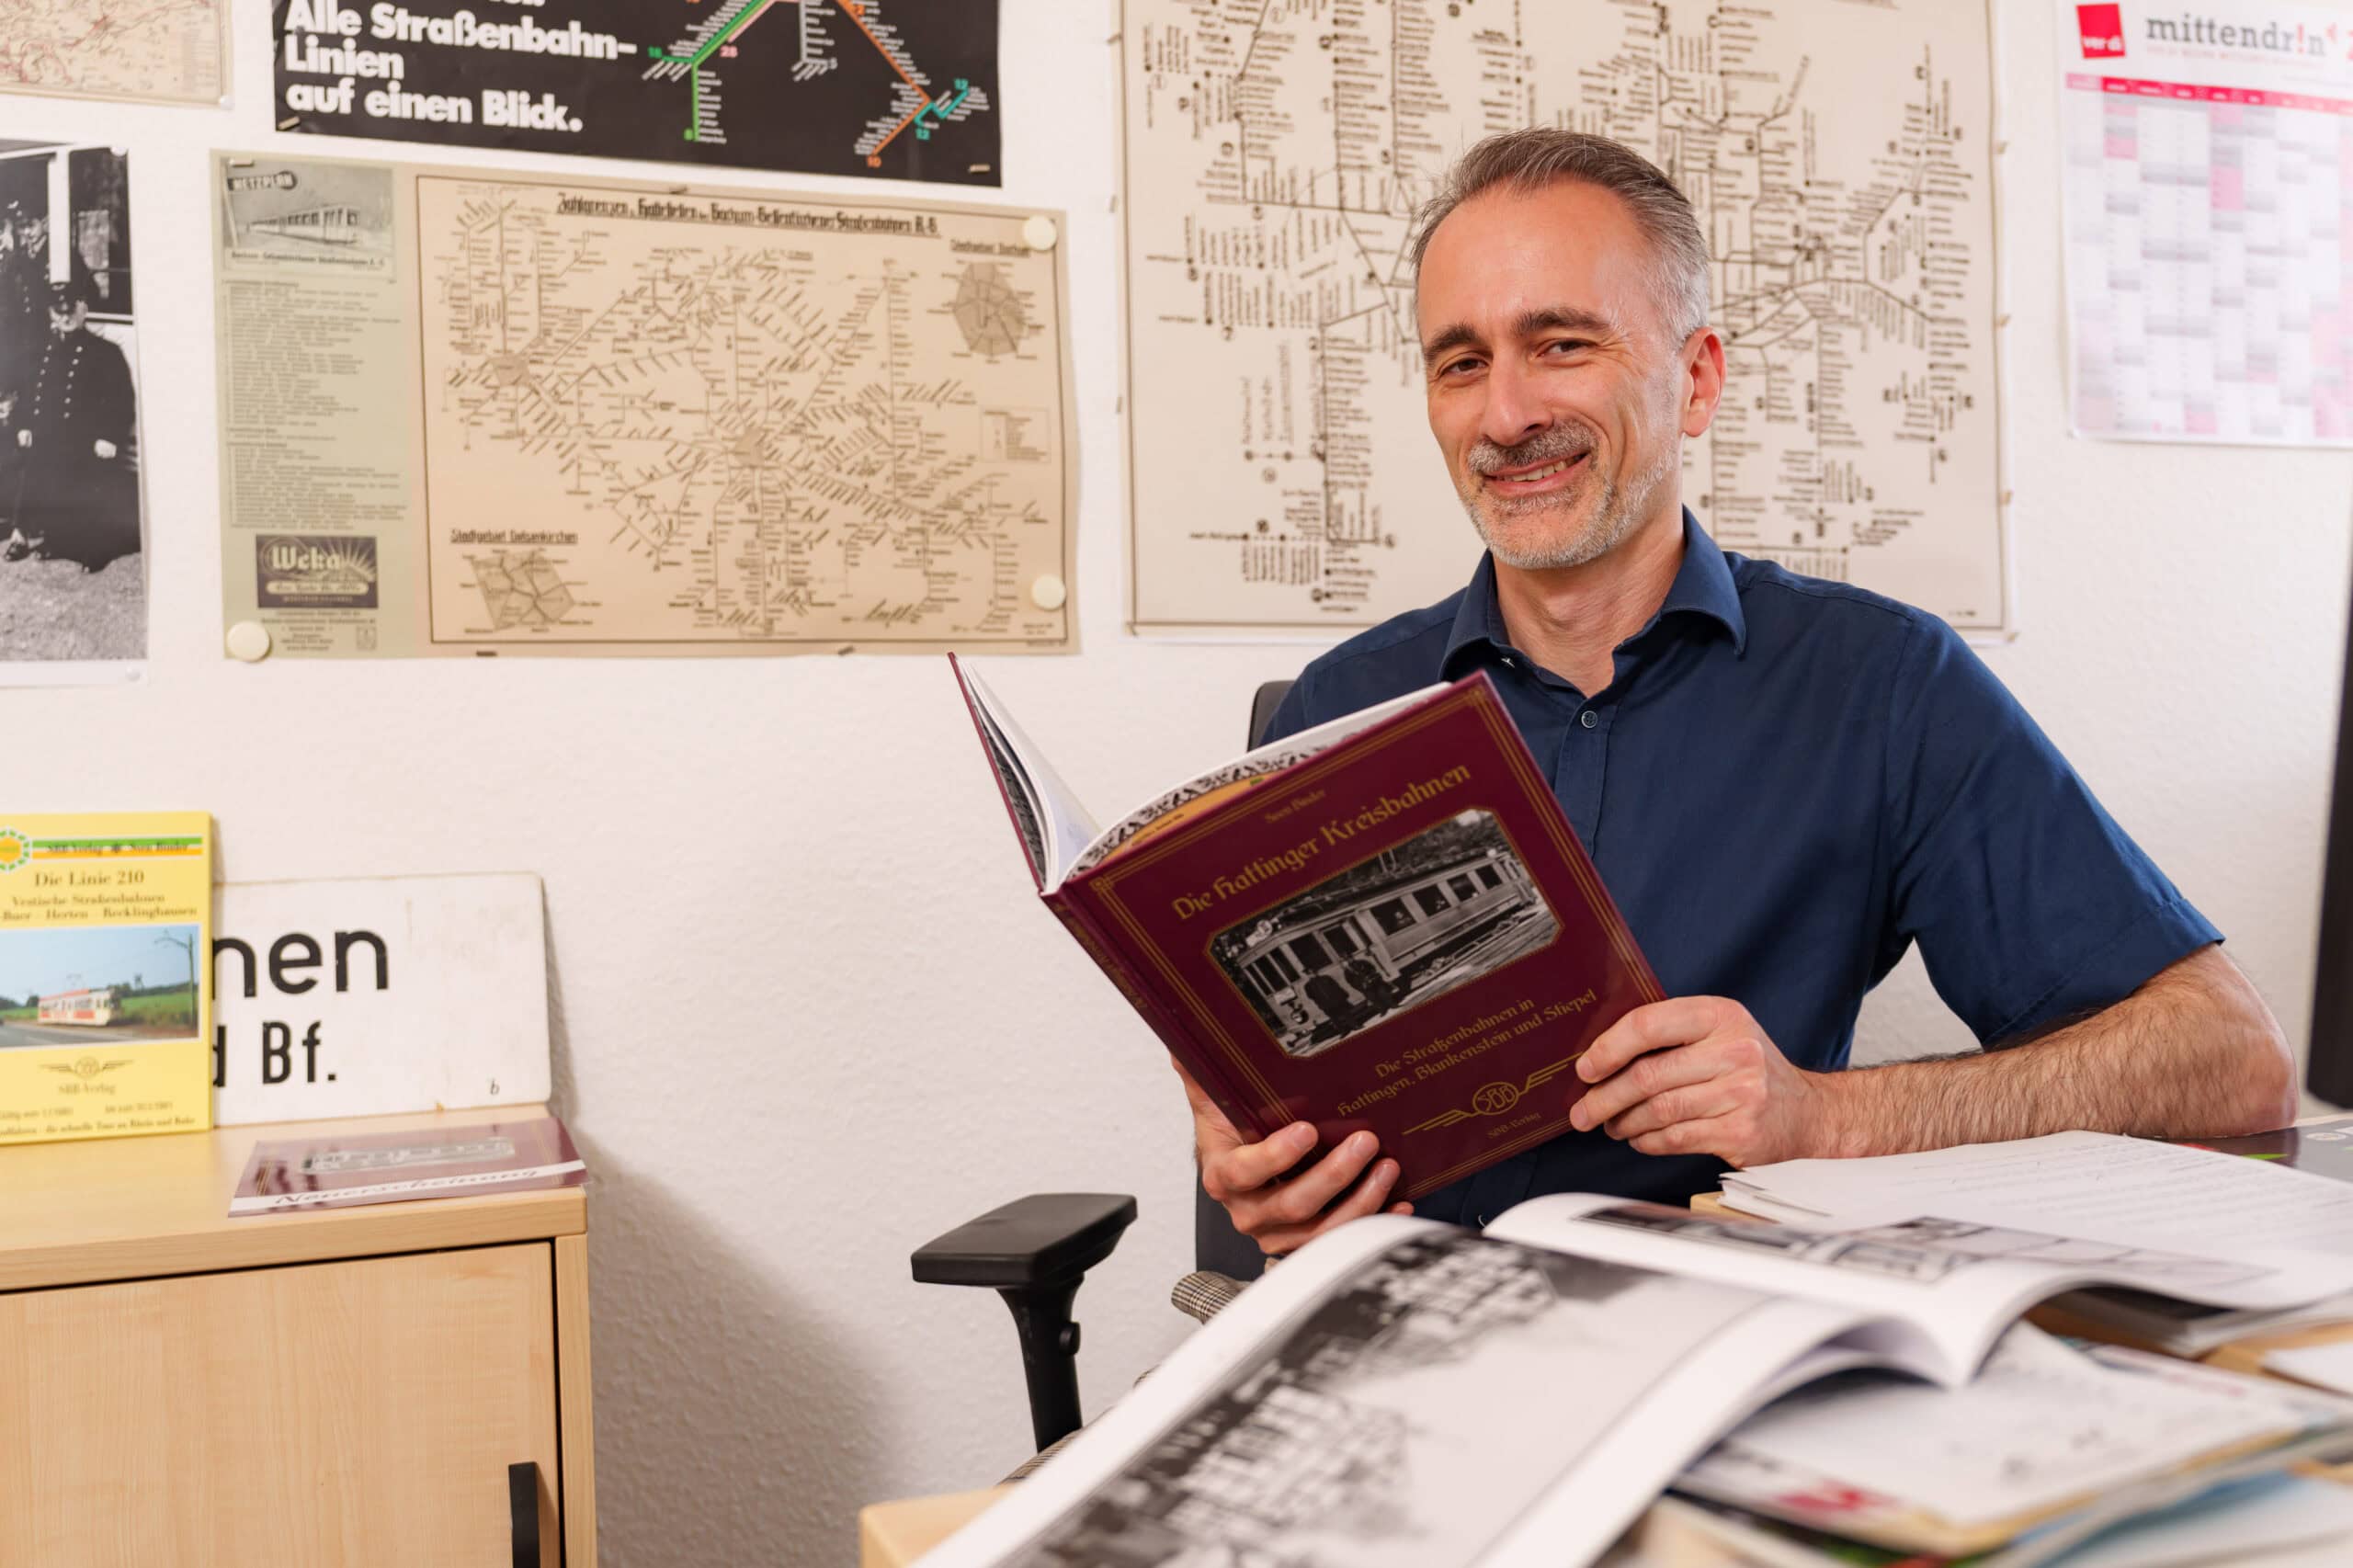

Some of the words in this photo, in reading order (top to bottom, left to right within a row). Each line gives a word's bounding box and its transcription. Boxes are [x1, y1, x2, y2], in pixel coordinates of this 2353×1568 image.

[284, 0, 362, 36] Alle
[285, 34, 405, 80] Linien
[286, 77, 356, 115] auf
[364, 81, 473, 123] einen
[482, 89, 584, 133] Blick.
[1171, 891, 1214, 920] Die
[1211, 835, 1322, 901] Hattinger
[1321, 764, 1472, 846] Kreisbahnen
[34, 871, 63, 887] Die
[68, 870, 111, 886] Linie
[118, 869, 145, 885] 210
[103, 905, 198, 920] Recklinghausen
[262, 1020, 336, 1085] Bf.
[1374, 1058, 1402, 1079] Die
[1402, 1006, 1518, 1065] Straßenbahnen
[1517, 996, 1536, 1012] in
[1413, 1028, 1513, 1083] Blankenstein
[1512, 1015, 1543, 1036] und
[1542, 988, 1597, 1023] Stiepel
